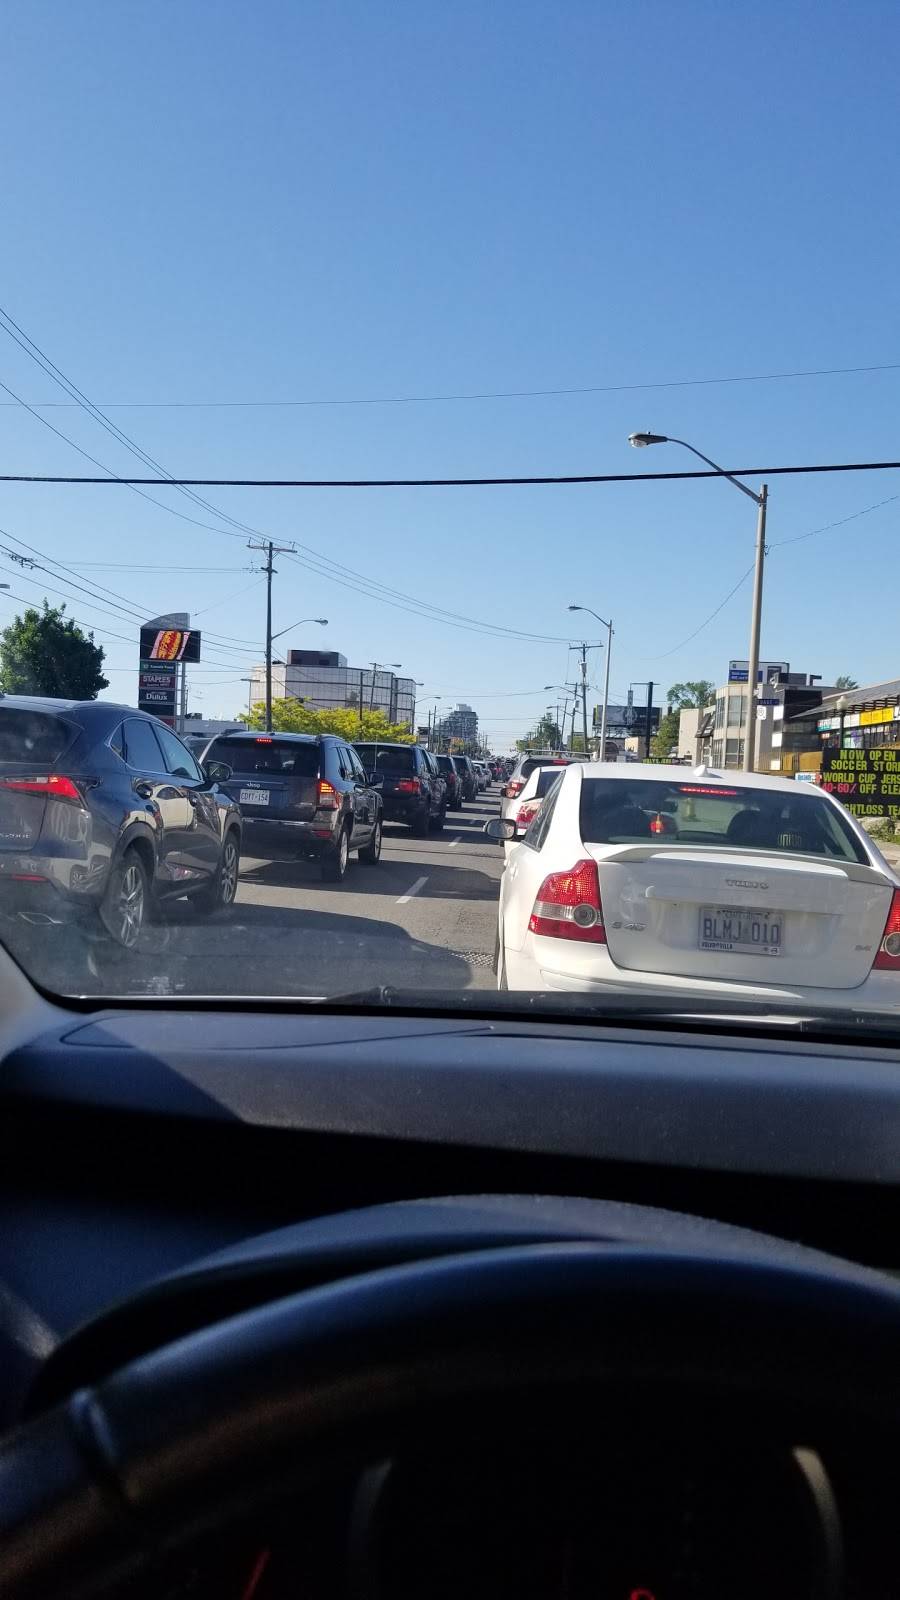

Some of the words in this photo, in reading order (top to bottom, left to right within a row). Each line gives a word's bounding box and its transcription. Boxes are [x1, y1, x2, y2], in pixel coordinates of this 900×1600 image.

[143, 675, 171, 683] STAPLES
[146, 693, 168, 701] Dulux
[840, 749, 865, 760] NOW
[869, 750, 896, 761] OPEN
[831, 760, 867, 771] SOCCER
[823, 772, 855, 783] WORLD
[858, 773, 876, 784] CUP
[859, 783, 877, 794] OFF
[881, 784, 900, 795] CLE
[703, 917, 742, 941] BLMJ
[751, 921, 780, 945] 010
